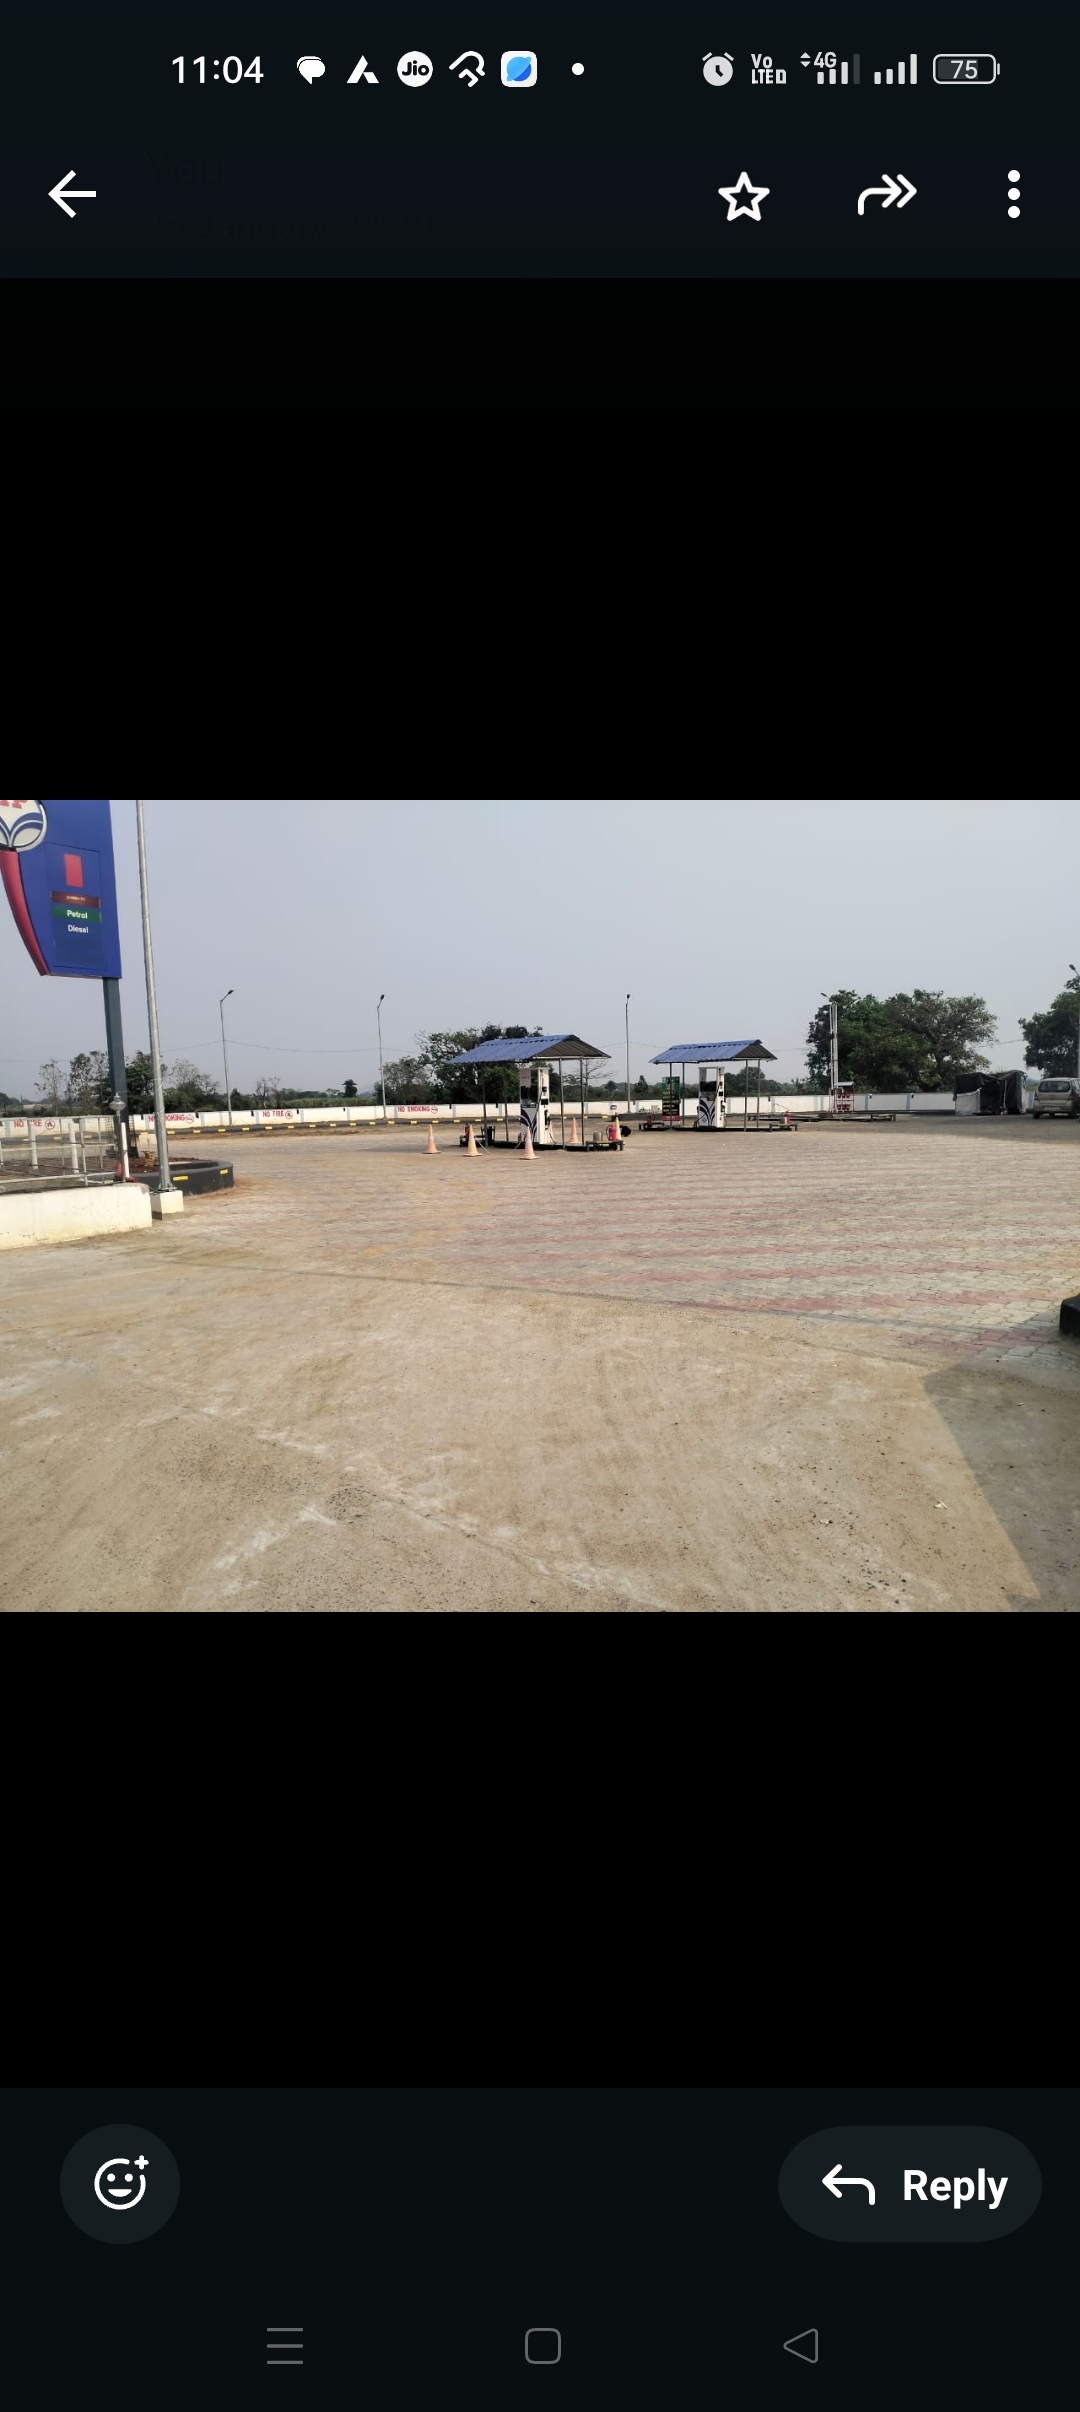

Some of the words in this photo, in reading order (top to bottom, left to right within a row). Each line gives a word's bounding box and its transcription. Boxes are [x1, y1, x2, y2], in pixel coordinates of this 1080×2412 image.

[814, 51, 837, 68] 4G
[173, 56, 255, 80] 11:04
[402, 60, 427, 75] Jio
[950, 60, 978, 79] 75
[66, 909, 88, 920] Petrol
[67, 924, 89, 934] Diesel
[262, 1110, 271, 1118] NO
[13, 1119, 25, 1128] NO
[904, 2168, 1008, 2209] Reply
